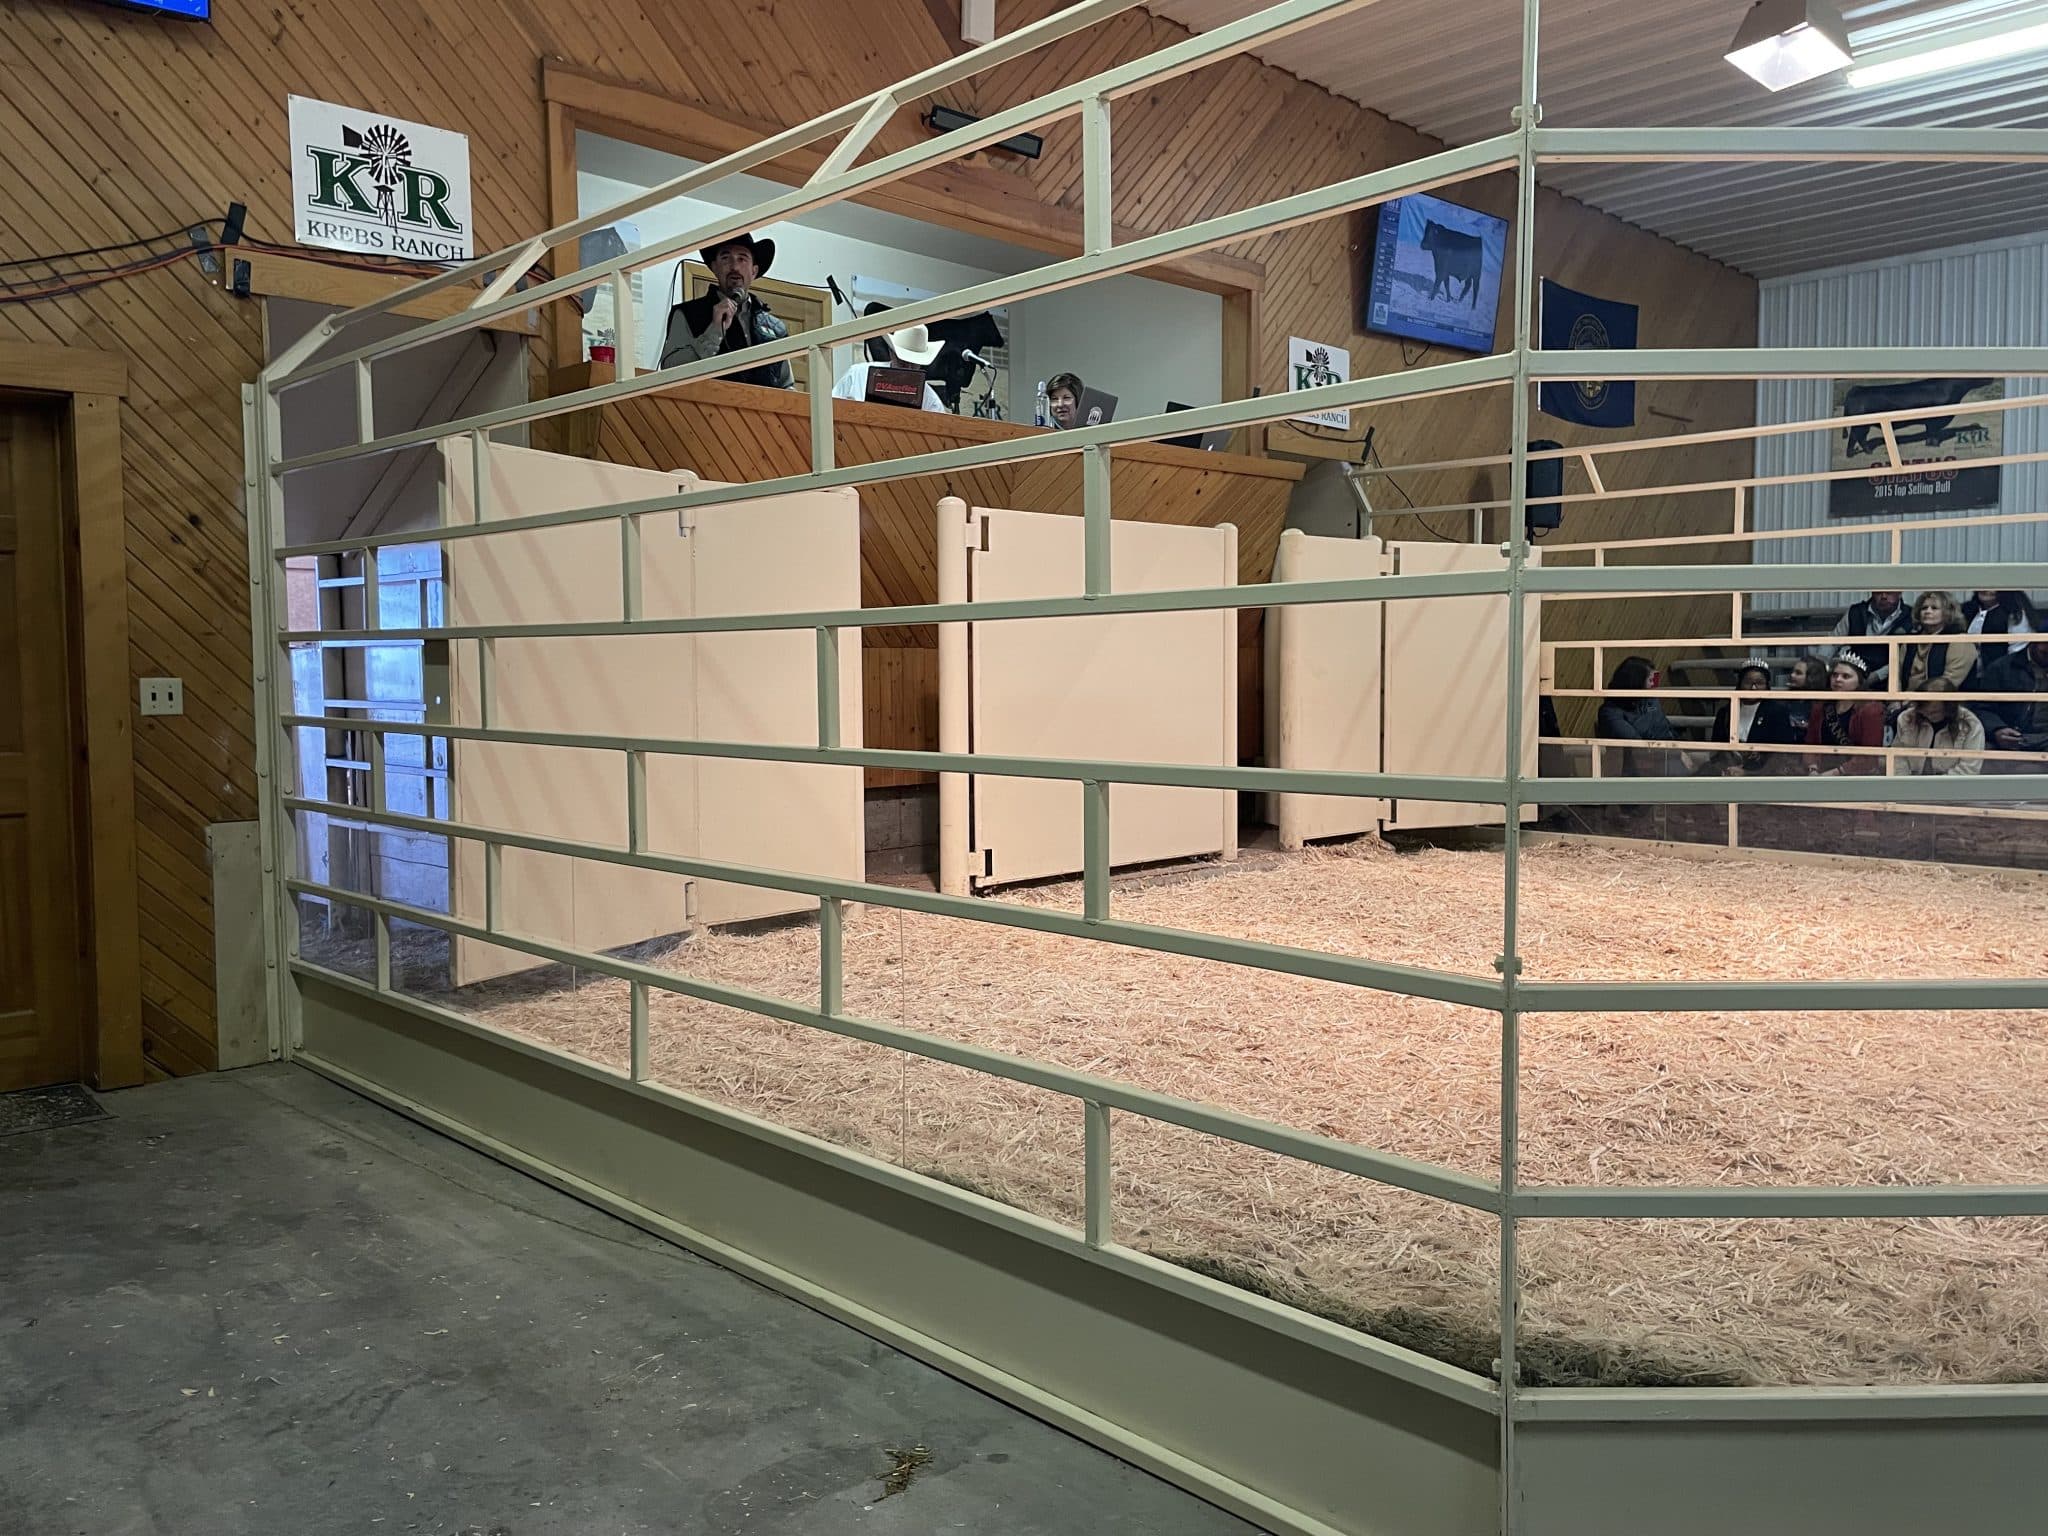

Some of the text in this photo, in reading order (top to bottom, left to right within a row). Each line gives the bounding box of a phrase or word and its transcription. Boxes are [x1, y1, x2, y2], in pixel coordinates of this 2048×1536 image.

[306, 219, 465, 262] KREBS RANCH
[1321, 411, 1347, 425] RANCH
[1874, 480, 1951, 498] 2015 Top Selling Bull
